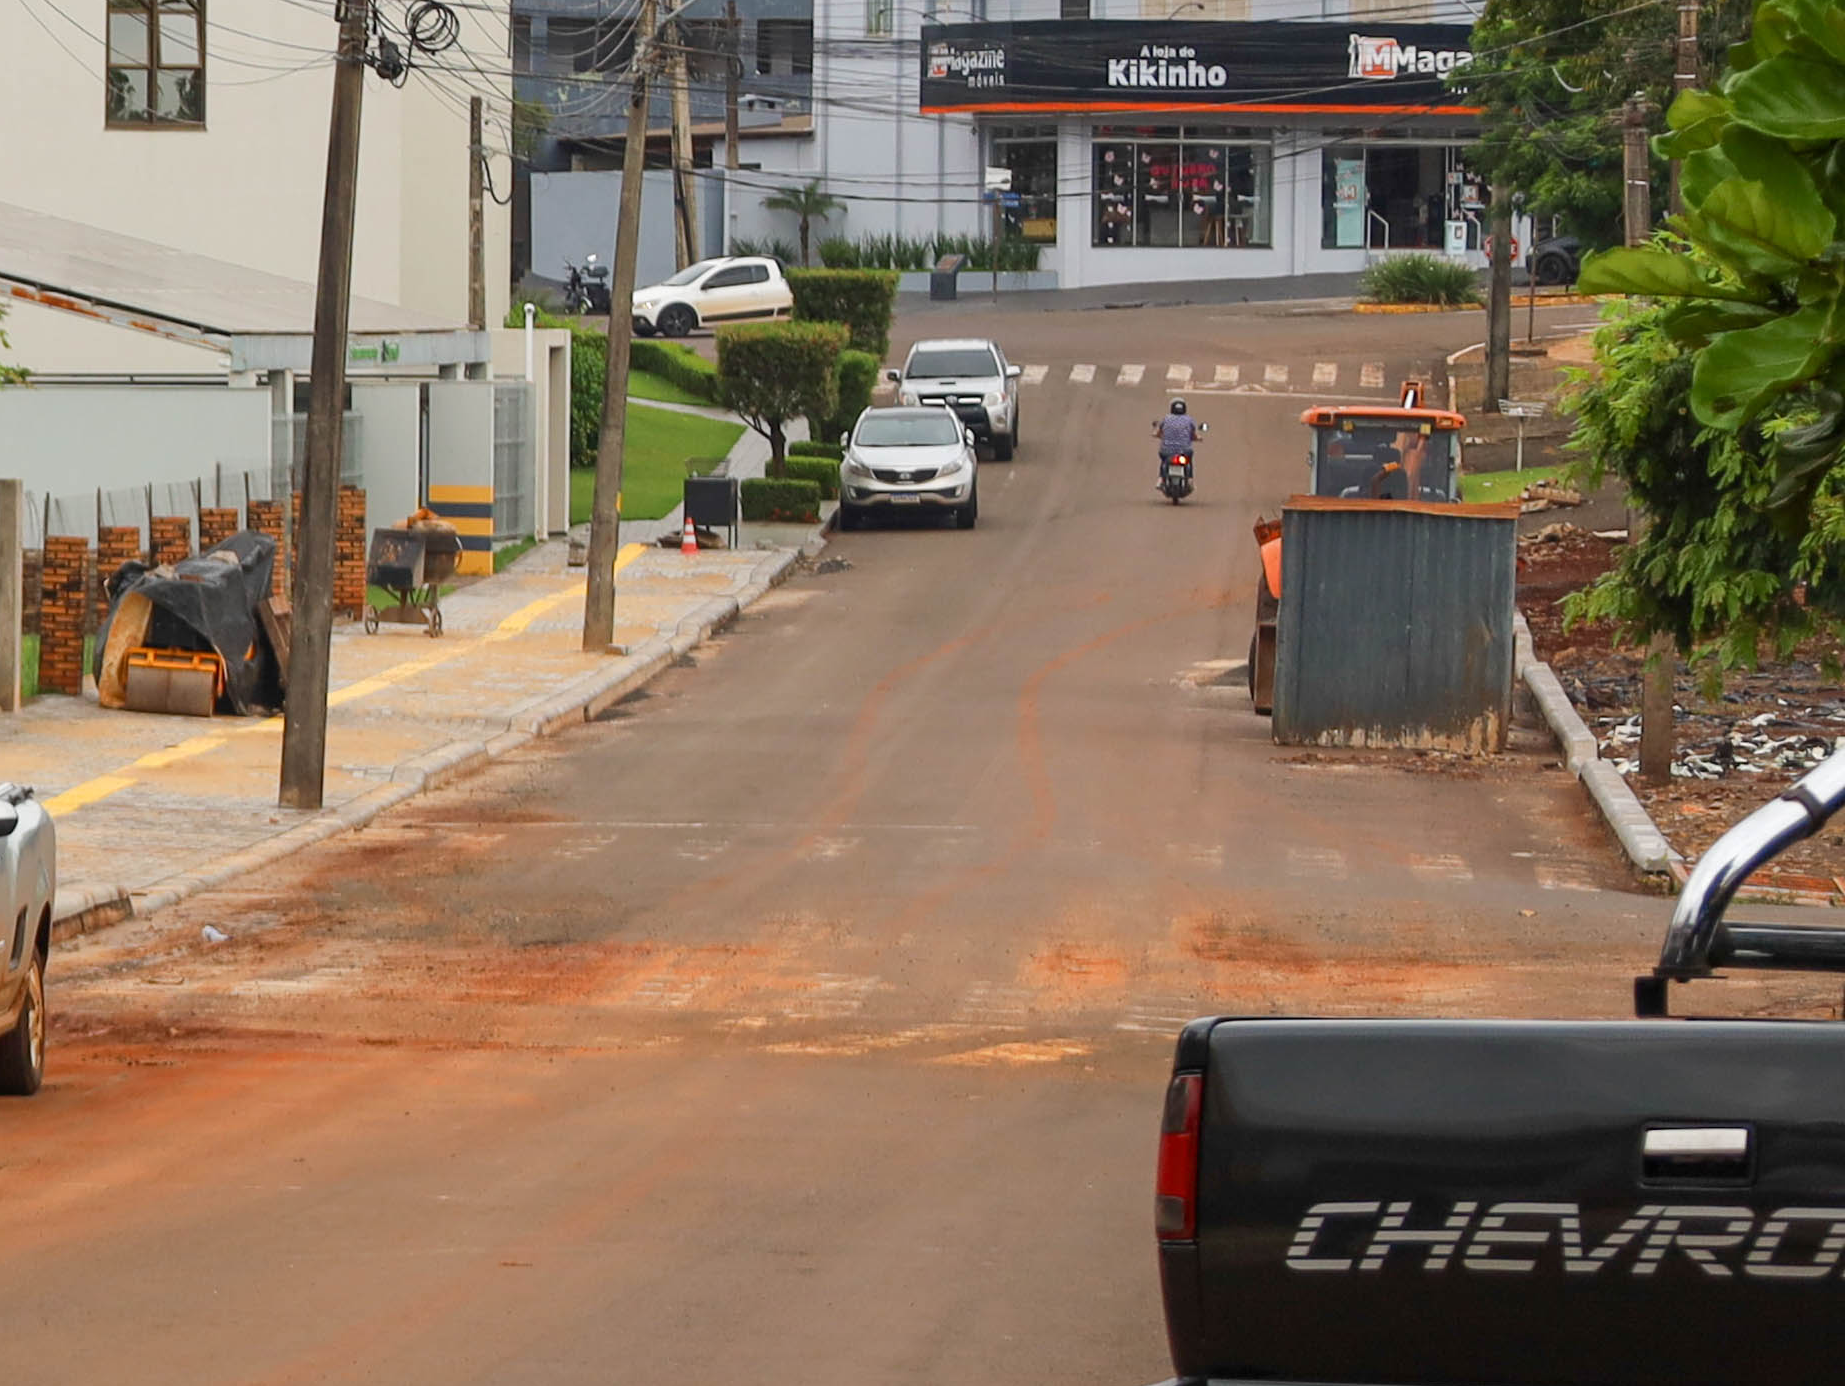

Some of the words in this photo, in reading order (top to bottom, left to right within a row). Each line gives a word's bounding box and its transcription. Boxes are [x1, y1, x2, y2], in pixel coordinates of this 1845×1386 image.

[1140, 45, 1150, 58] A
[1152, 45, 1177, 59] loja
[1179, 45, 1196, 58] do
[1395, 45, 1474, 80] Maga
[1108, 59, 1228, 87] Kikinho
[1285, 1201, 1845, 1277] CHEVRO
